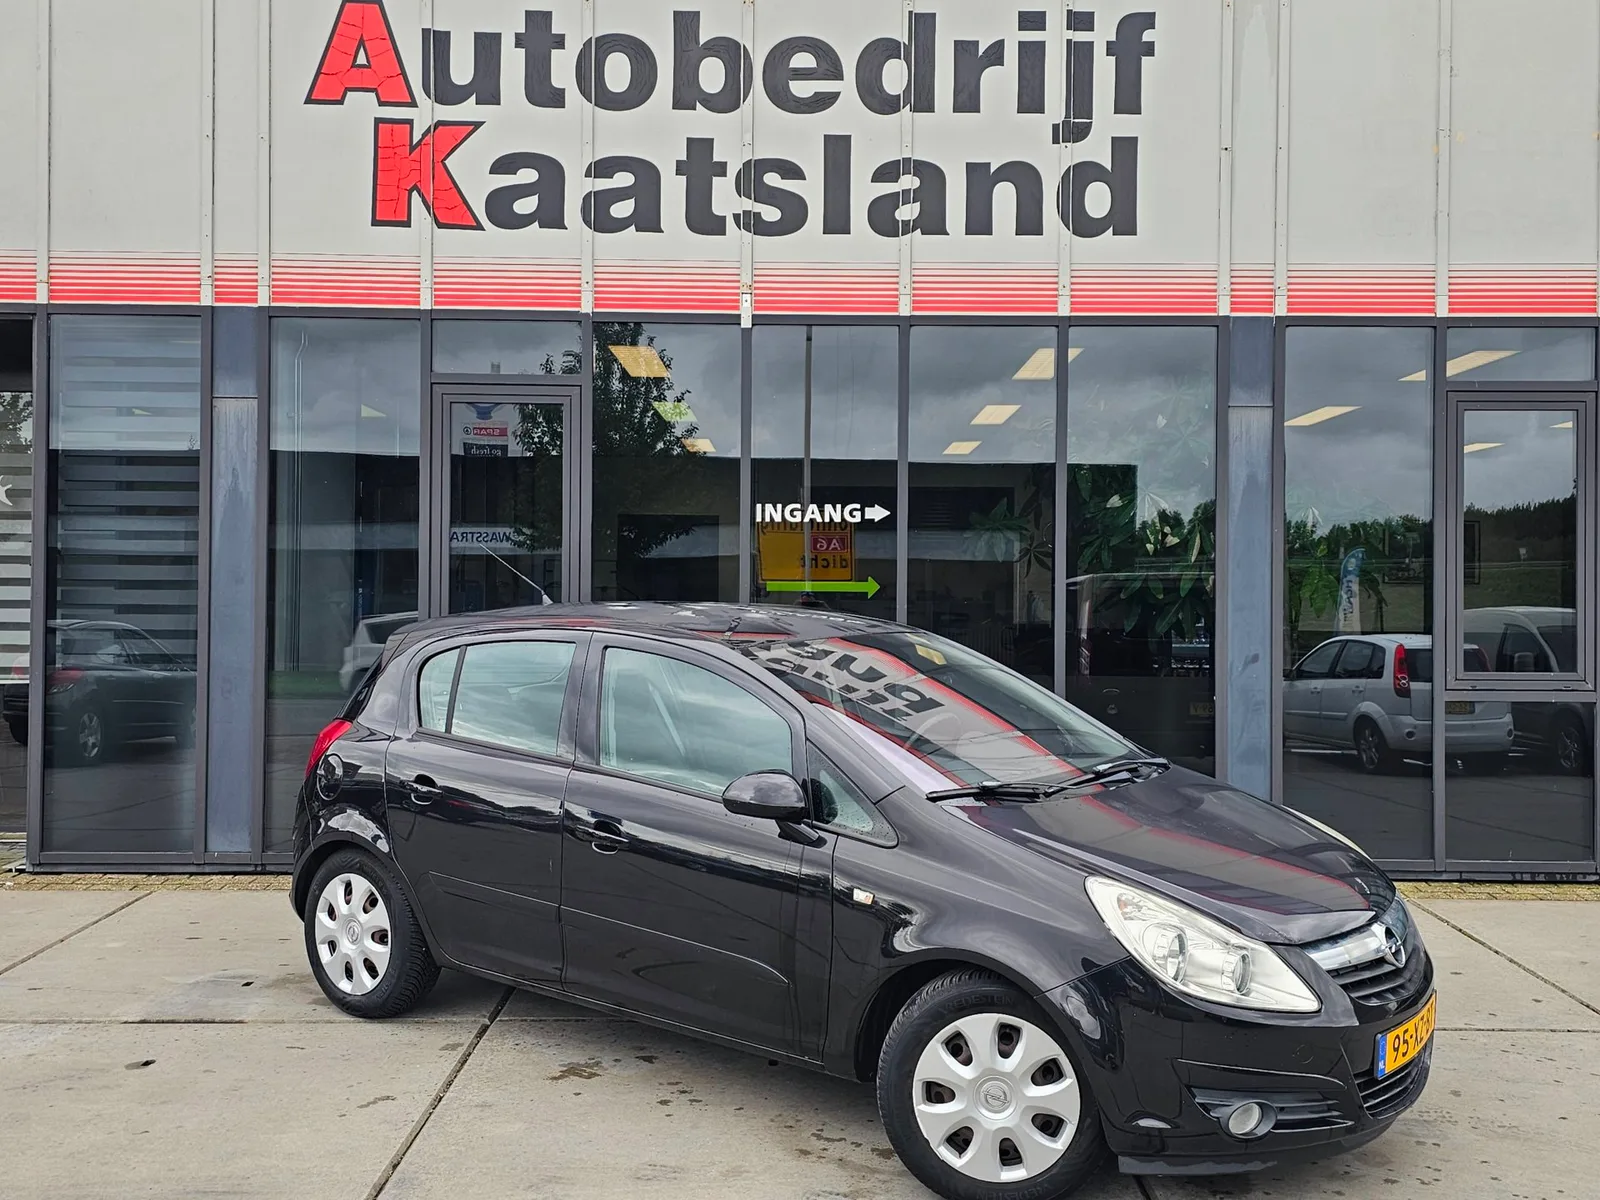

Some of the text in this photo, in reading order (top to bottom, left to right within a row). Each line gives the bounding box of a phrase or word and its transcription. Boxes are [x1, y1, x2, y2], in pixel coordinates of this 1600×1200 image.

[303, 0, 1157, 144] Autobedrijf
[371, 118, 1139, 239] Kaatsland
[755, 503, 862, 523] INGANG
